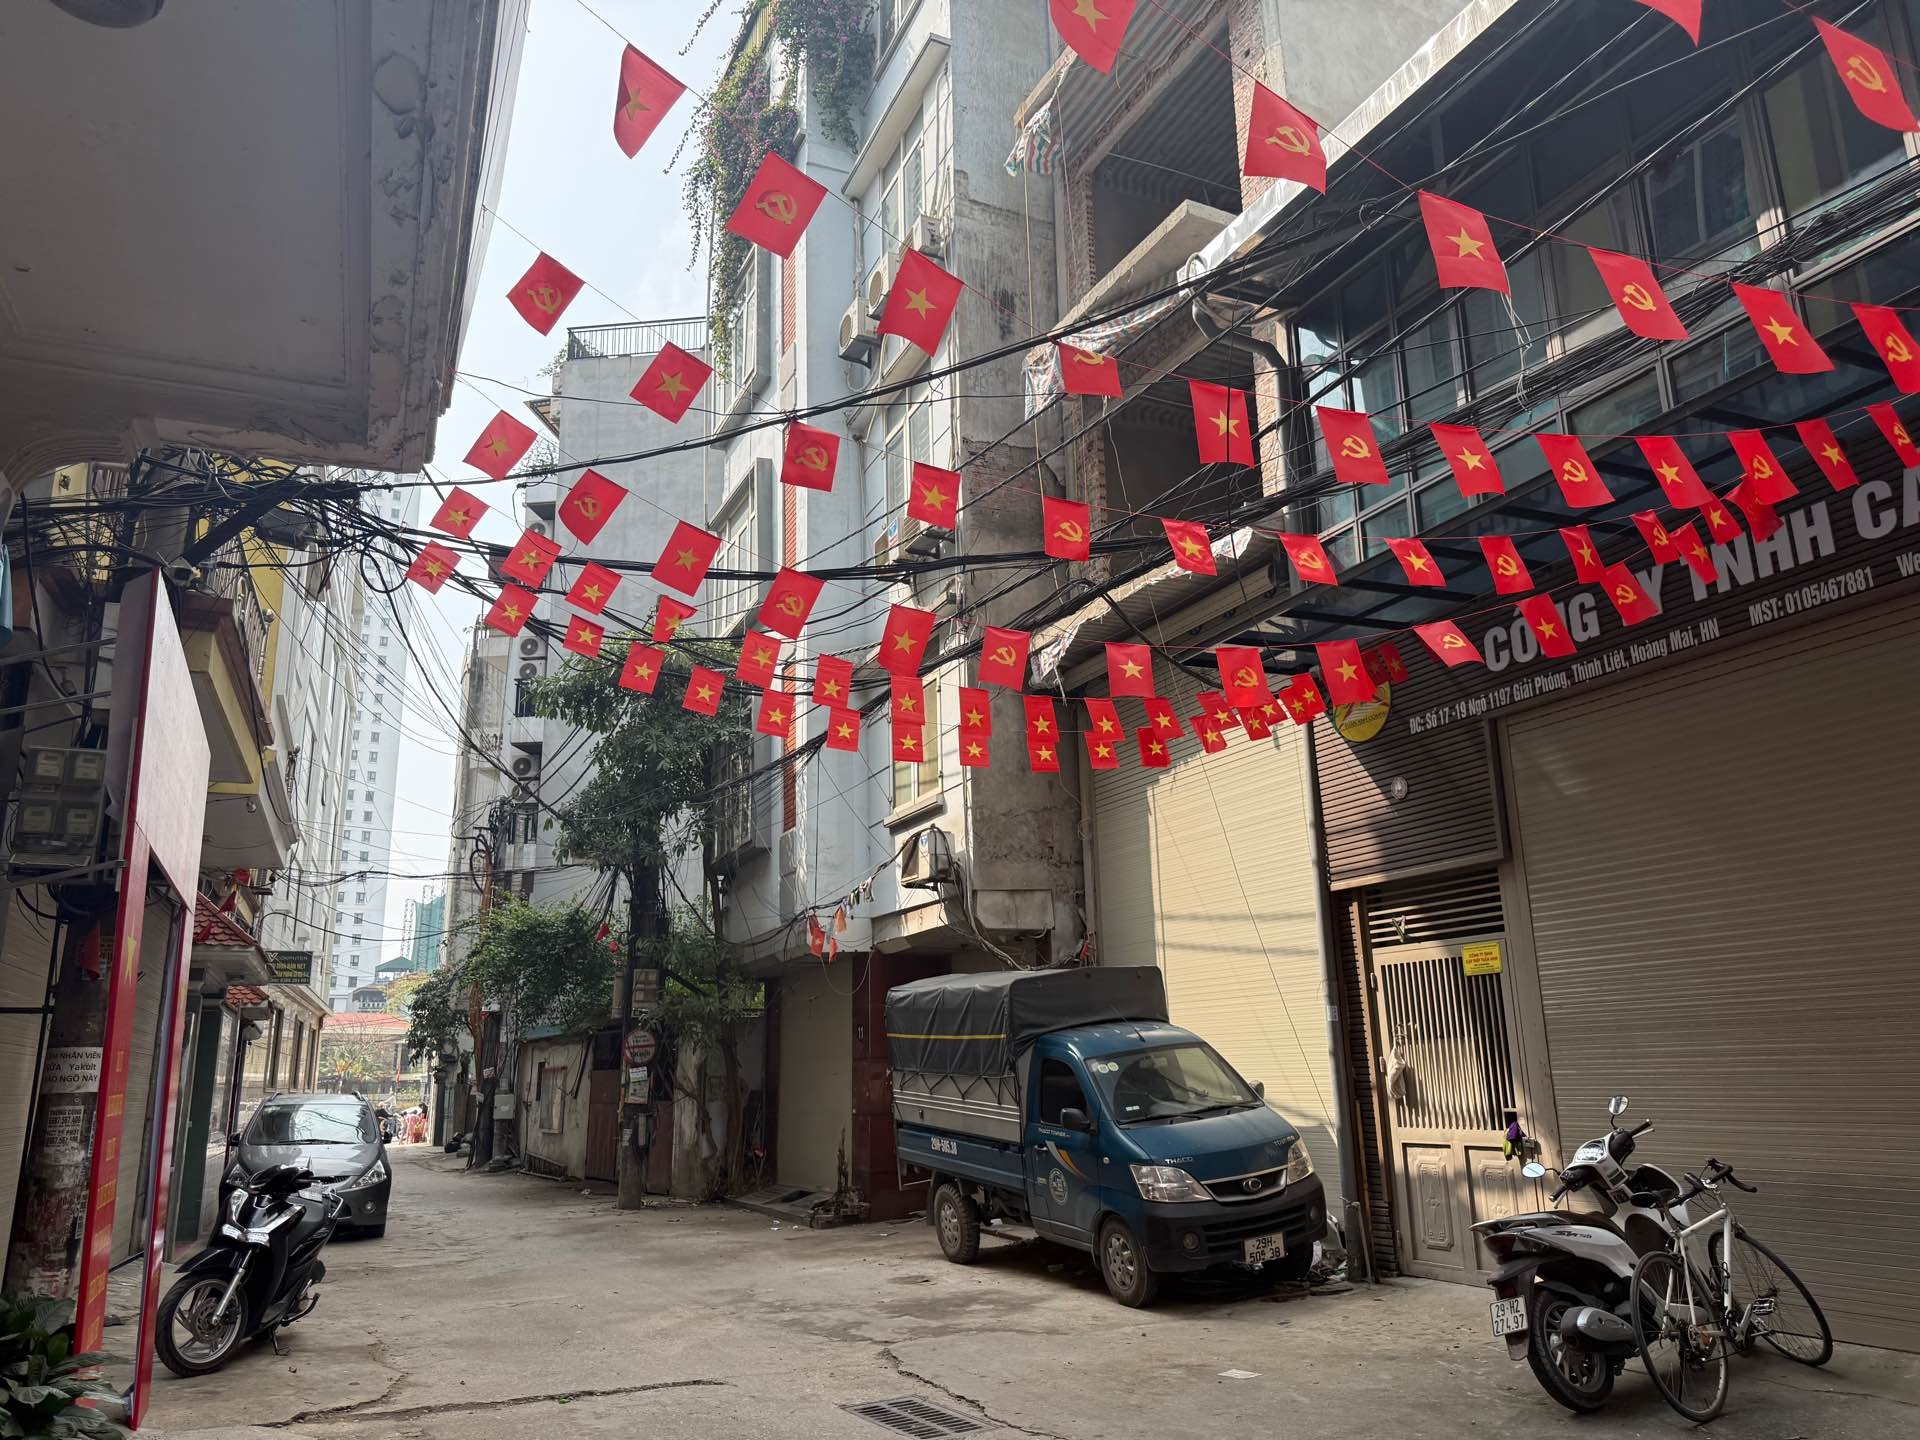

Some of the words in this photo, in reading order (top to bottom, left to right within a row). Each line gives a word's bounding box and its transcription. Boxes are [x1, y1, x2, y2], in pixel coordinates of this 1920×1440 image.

[1483, 592, 1601, 672] CÔG
[1425, 708, 1438, 729] Số
[1438, 707, 1450, 724] 17
[1489, 690, 1511, 709] 1197
[1513, 679, 1533, 702] Giải
[1534, 671, 1571, 695] Phóng,
[1571, 658, 1602, 684] Thịnh
[1603, 650, 1630, 673] Liệt,
[1630, 640, 1668, 665] Hoàng
[1669, 626, 1698, 651] Mai,
[1699, 618, 1720, 642] HN
[1748, 601, 1784, 626] MST:
[1784, 565, 1875, 614] 0105467881
[81, 1073, 98, 1082] NÀY
[1164, 1156, 1193, 1165] THACO
[1494, 1313, 1525, 1335] 274.97
